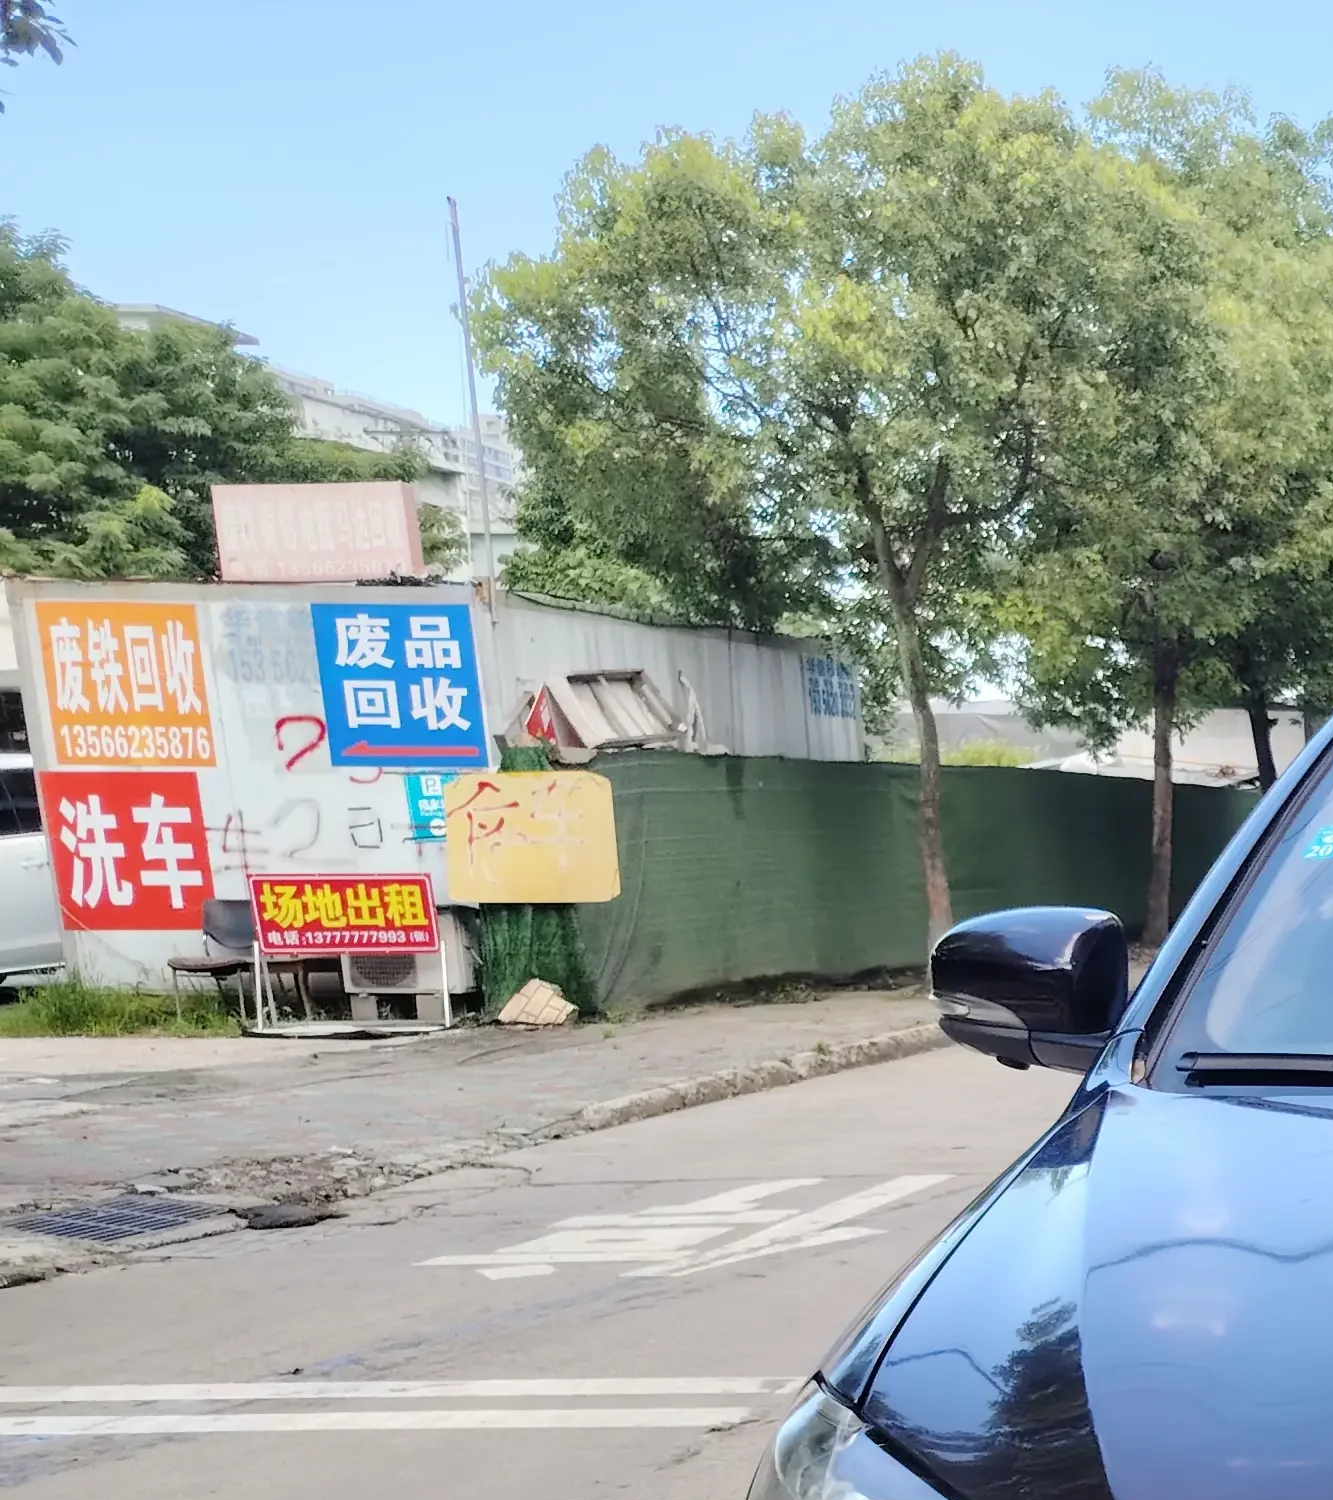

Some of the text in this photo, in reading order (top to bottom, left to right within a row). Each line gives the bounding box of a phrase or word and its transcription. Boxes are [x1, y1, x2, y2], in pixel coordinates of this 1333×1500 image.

[50, 617, 202, 715] 废铁回收
[335, 613, 462, 669] 废品
[343, 676, 472, 731] 回收
[60, 724, 211, 760] 13566235876
[59, 793, 203, 910] 洗车
[260, 881, 429, 928] 场地出租
